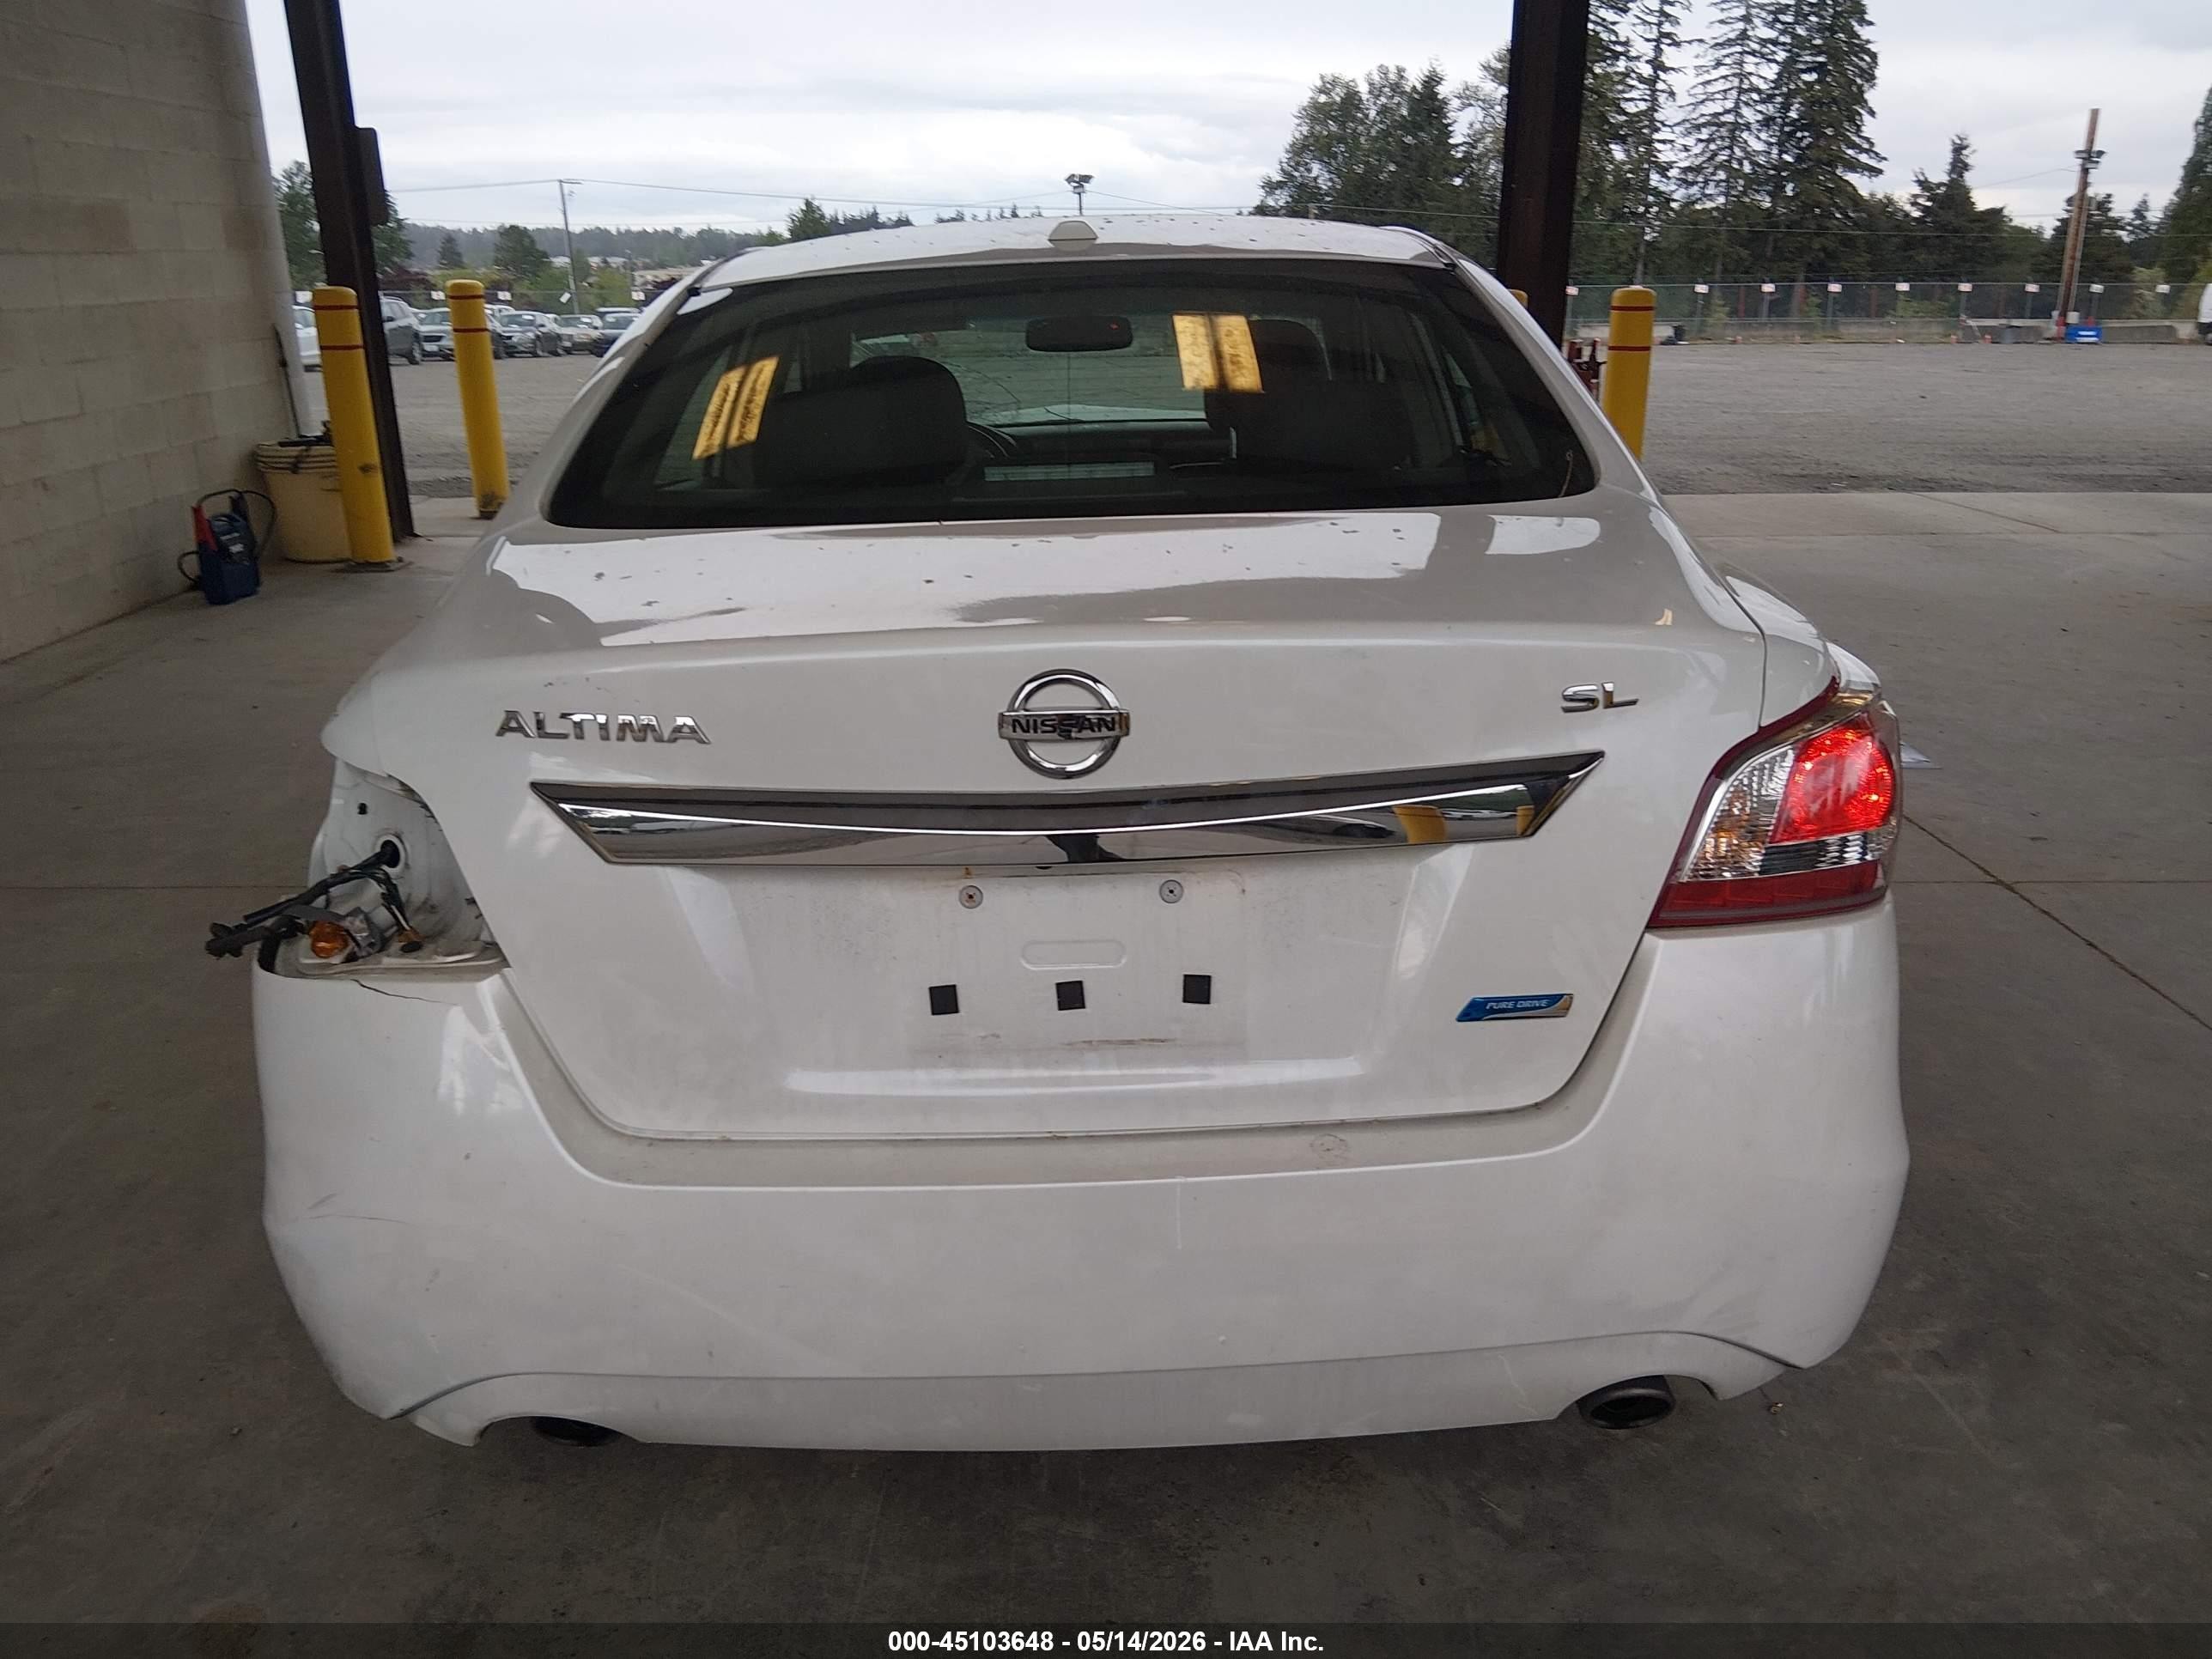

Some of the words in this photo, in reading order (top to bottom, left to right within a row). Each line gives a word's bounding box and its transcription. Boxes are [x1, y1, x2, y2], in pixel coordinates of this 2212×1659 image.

[1561, 682, 1639, 714] SL
[495, 709, 711, 744] ALTIMA
[1012, 717, 1115, 734] NISSAN
[1516, 1000, 1551, 1008] DRIVE
